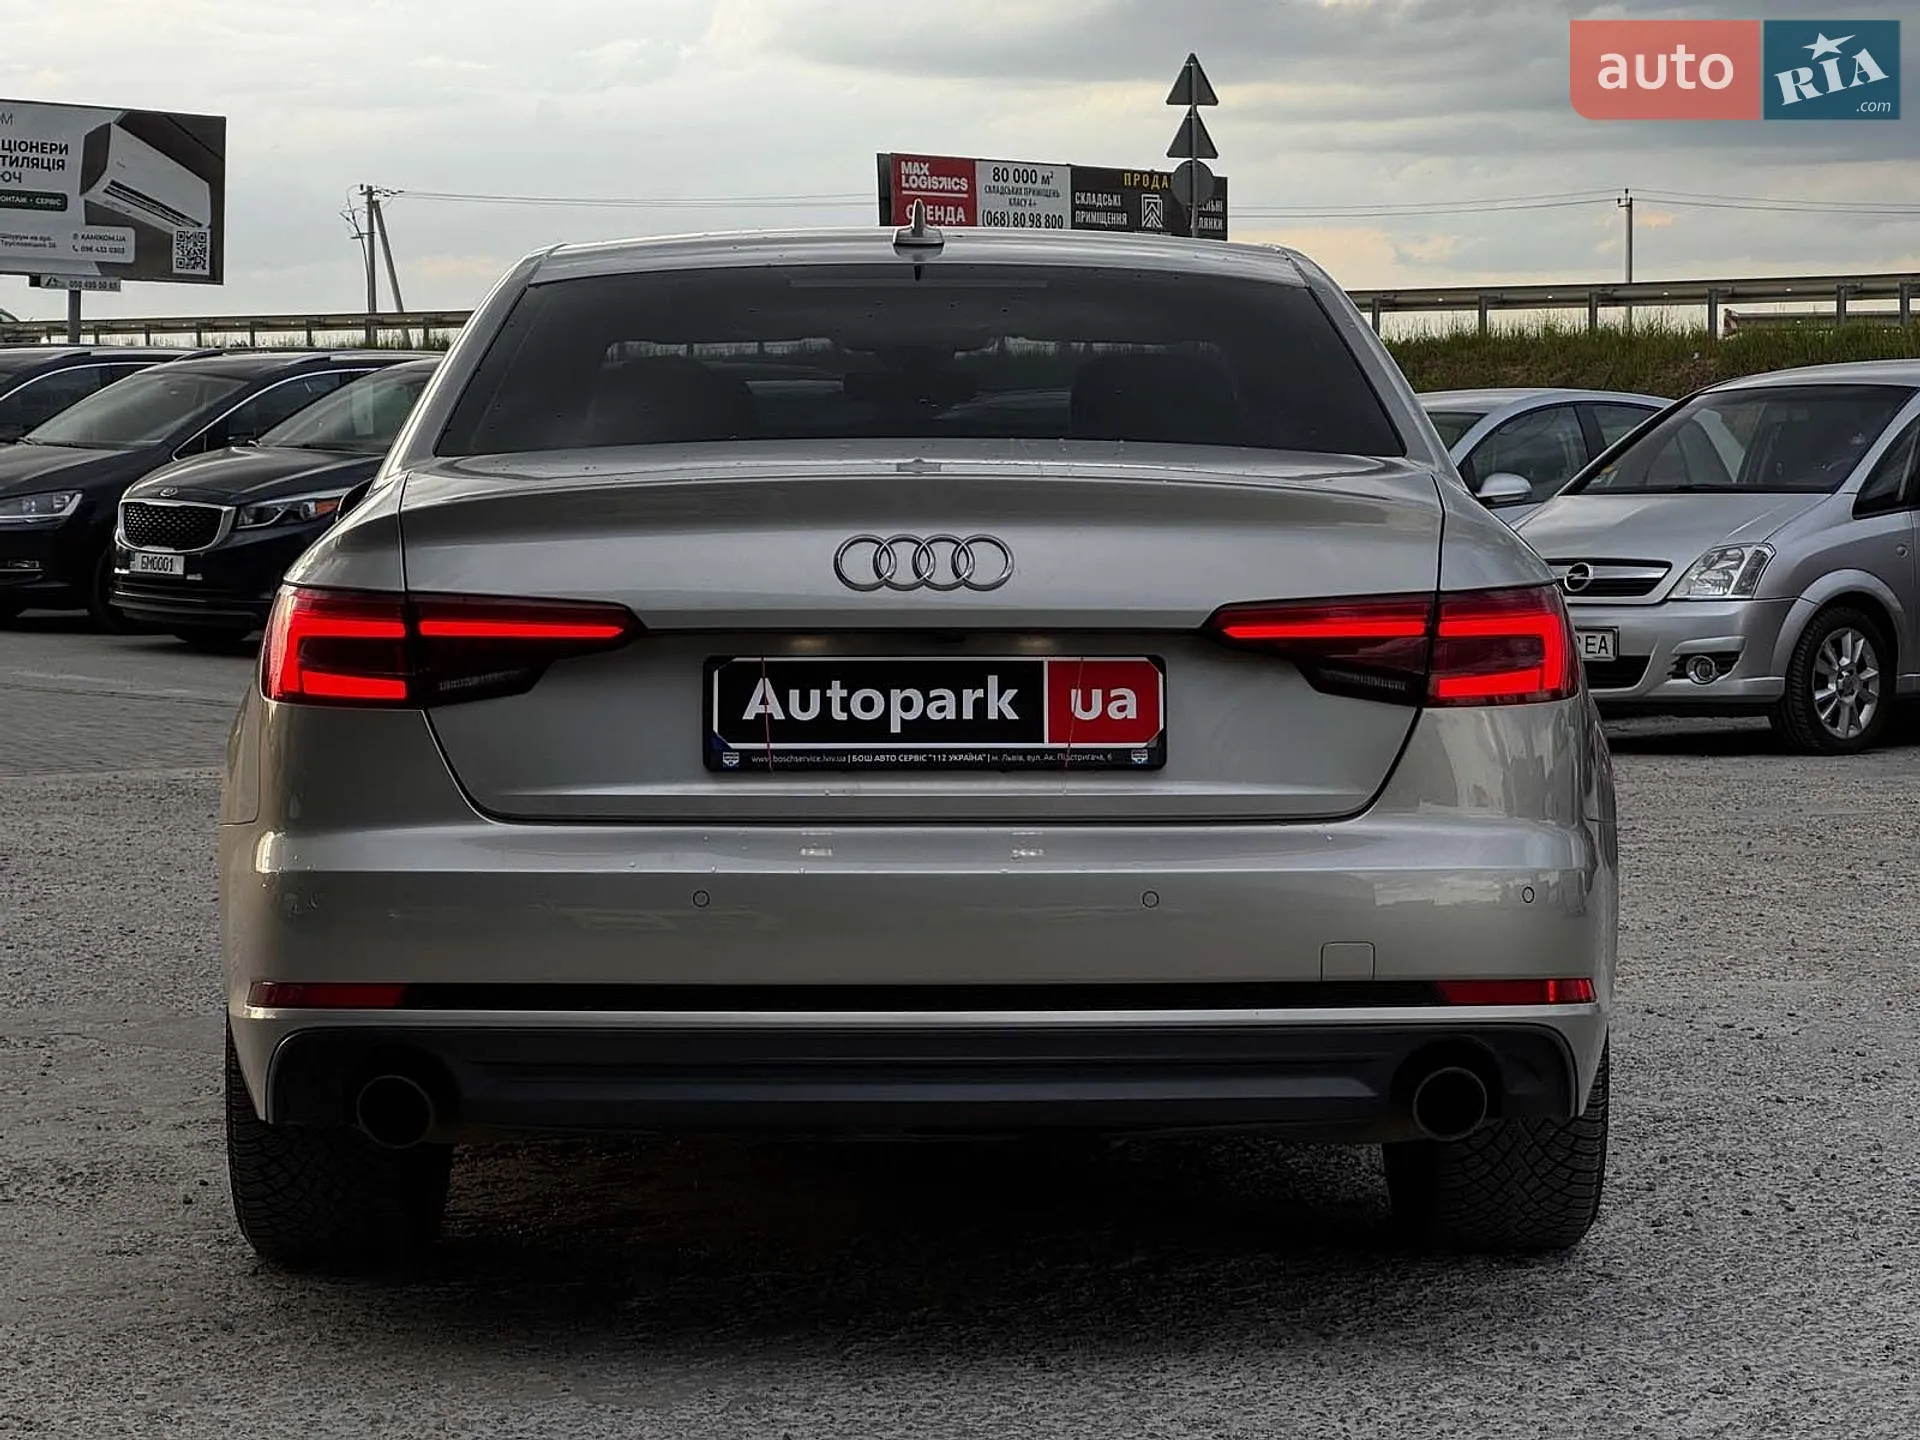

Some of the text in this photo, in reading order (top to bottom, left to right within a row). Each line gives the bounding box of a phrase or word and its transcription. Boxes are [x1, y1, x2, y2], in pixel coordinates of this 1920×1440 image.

[0, 112, 13, 125] M
[900, 160, 930, 176] MAX
[992, 167, 1008, 184] 80
[1012, 168, 1038, 185] 000
[1123, 172, 1173, 189] ПРОДА
[1075, 191, 1121, 208] СКЛАДСЬКІ
[905, 204, 966, 225] ОЕНДА
[981, 209, 1064, 229] (068) 80 98 800
[1075, 210, 1127, 227] ПРИМІЩЕННЯ
[742, 675, 1019, 733] Autopark
[1070, 686, 1137, 720] ua
[852, 754, 873, 763] БОШ
[873, 754, 897, 763] АВТО
[898, 754, 928, 763] СЕРВІС
